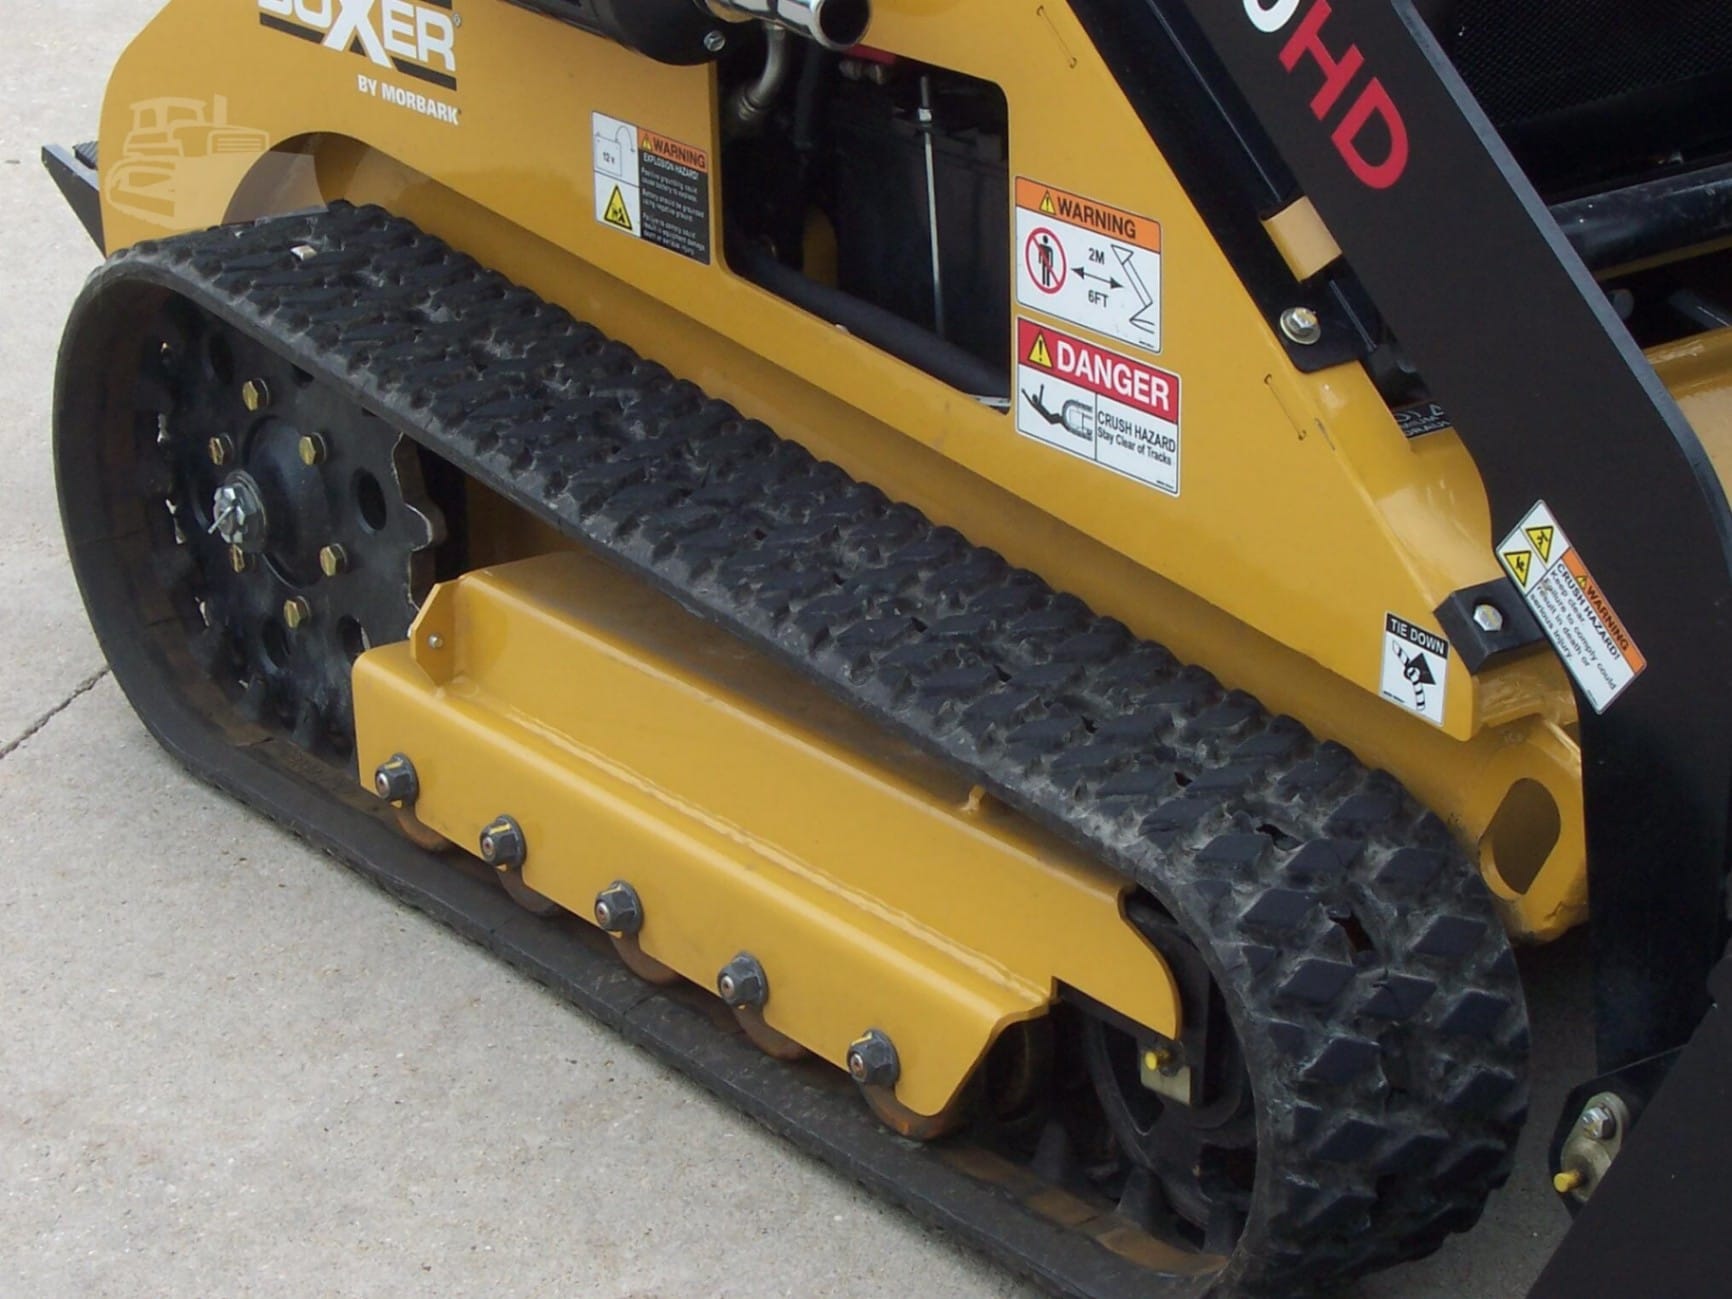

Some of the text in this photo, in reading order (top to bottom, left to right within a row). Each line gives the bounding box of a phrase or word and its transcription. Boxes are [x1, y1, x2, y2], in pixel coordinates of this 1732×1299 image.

[357, 74, 459, 125] BY MORBARK
[602, 152, 610, 163] 12
[653, 137, 705, 168] WARNING
[1058, 197, 1136, 239] WARNING
[1088, 248, 1105, 265] 2M
[1087, 289, 1109, 308] 6FT
[1057, 340, 1169, 411] DANGER
[1097, 426, 1172, 466] Stay Clear of Tracks
[1098, 410, 1176, 453] CRUSH HAZARD
[1550, 570, 1568, 597] Keep
[1530, 594, 1554, 629] serious
[1557, 563, 1620, 660] CRUSH HAZARD!
[1587, 585, 1629, 651] WARNING
[1391, 618, 1444, 655] TIE DOWN
[1555, 614, 1563, 626] in
[1563, 627, 1582, 655] death
[1581, 656, 1590, 667] or
[1566, 613, 1574, 625] to
[1574, 626, 1598, 661] comply
[1597, 663, 1617, 690] could
